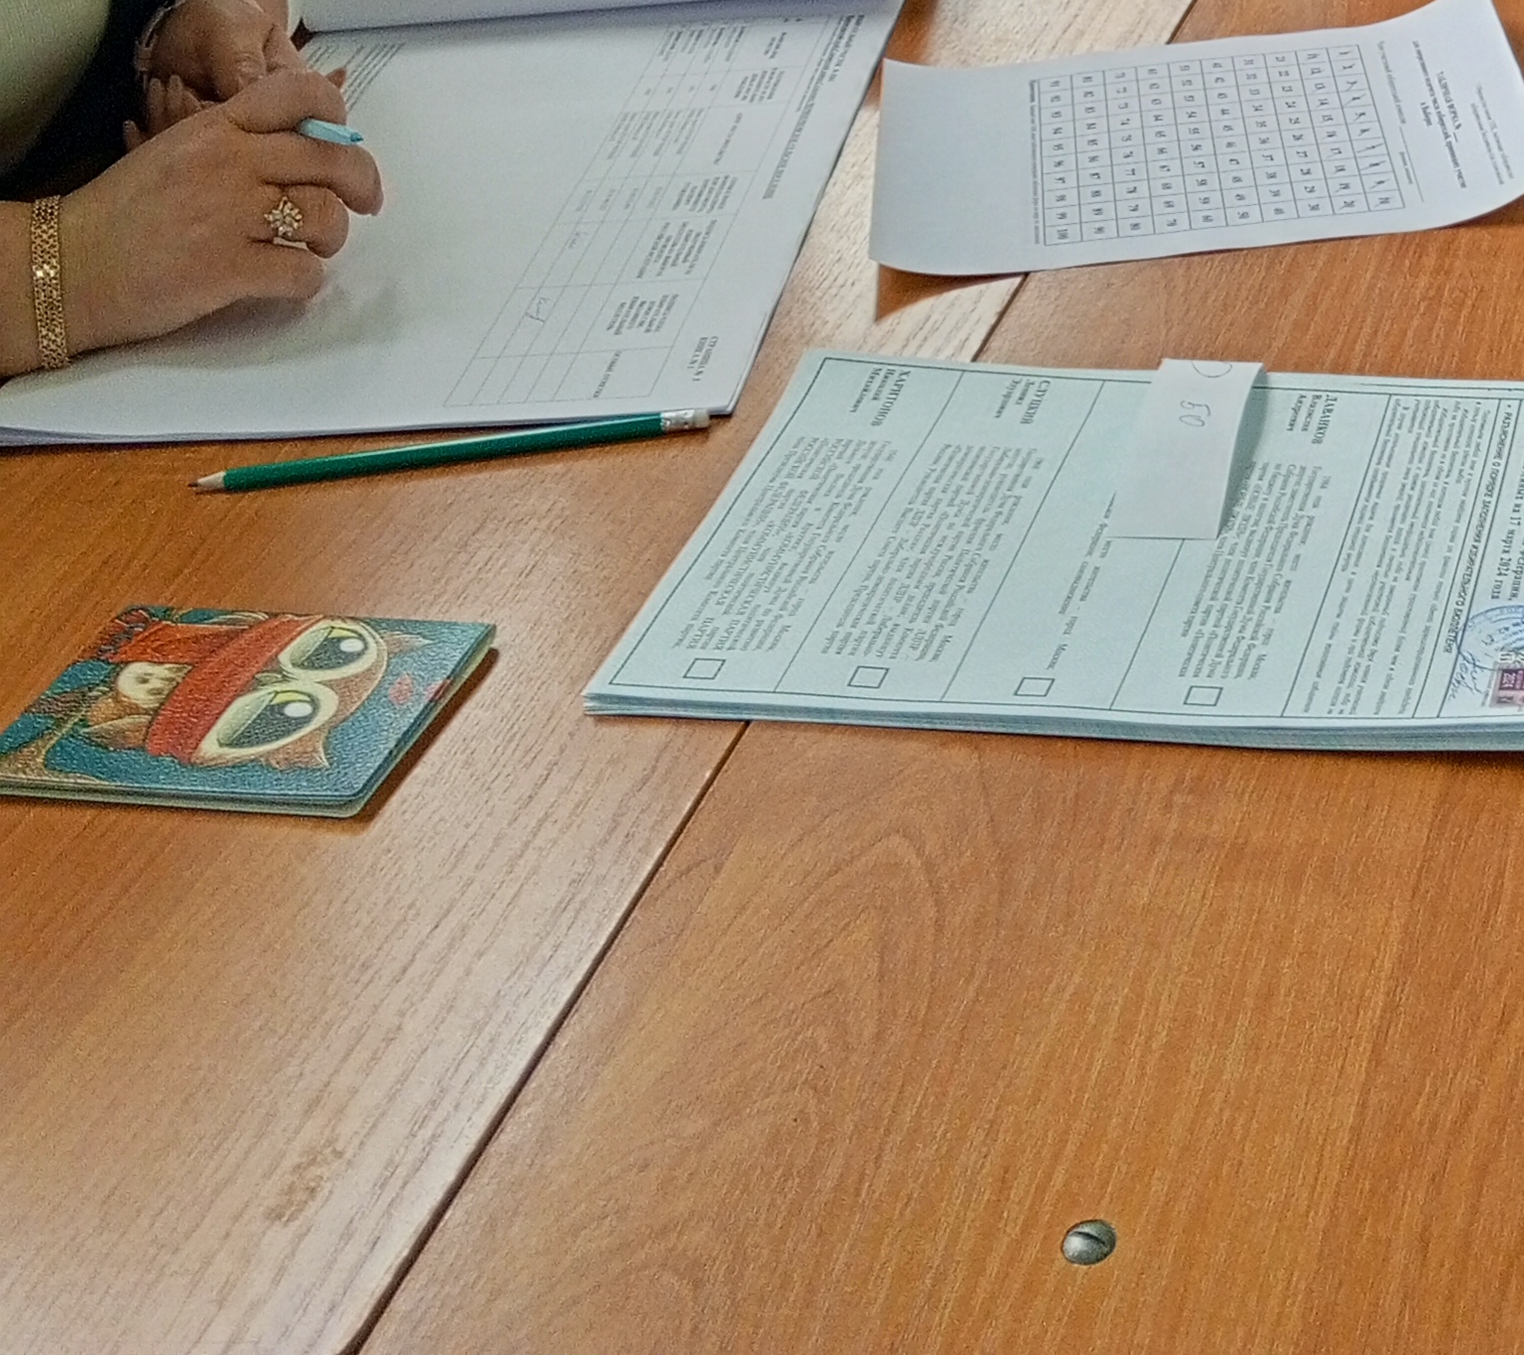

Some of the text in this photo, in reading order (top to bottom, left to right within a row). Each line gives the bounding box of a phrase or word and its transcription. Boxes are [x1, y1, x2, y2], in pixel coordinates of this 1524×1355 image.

[870, 369, 912, 427] ХАРИТОНОВ
[1019, 379, 1051, 425] СЛУЦКИЙ
[1178, 400, 1211, 428] 50
[1311, 393, 1338, 445] ДАВАНКОВ
[1509, 516, 1522, 527] 17
[1495, 556, 1513, 577] 2024
